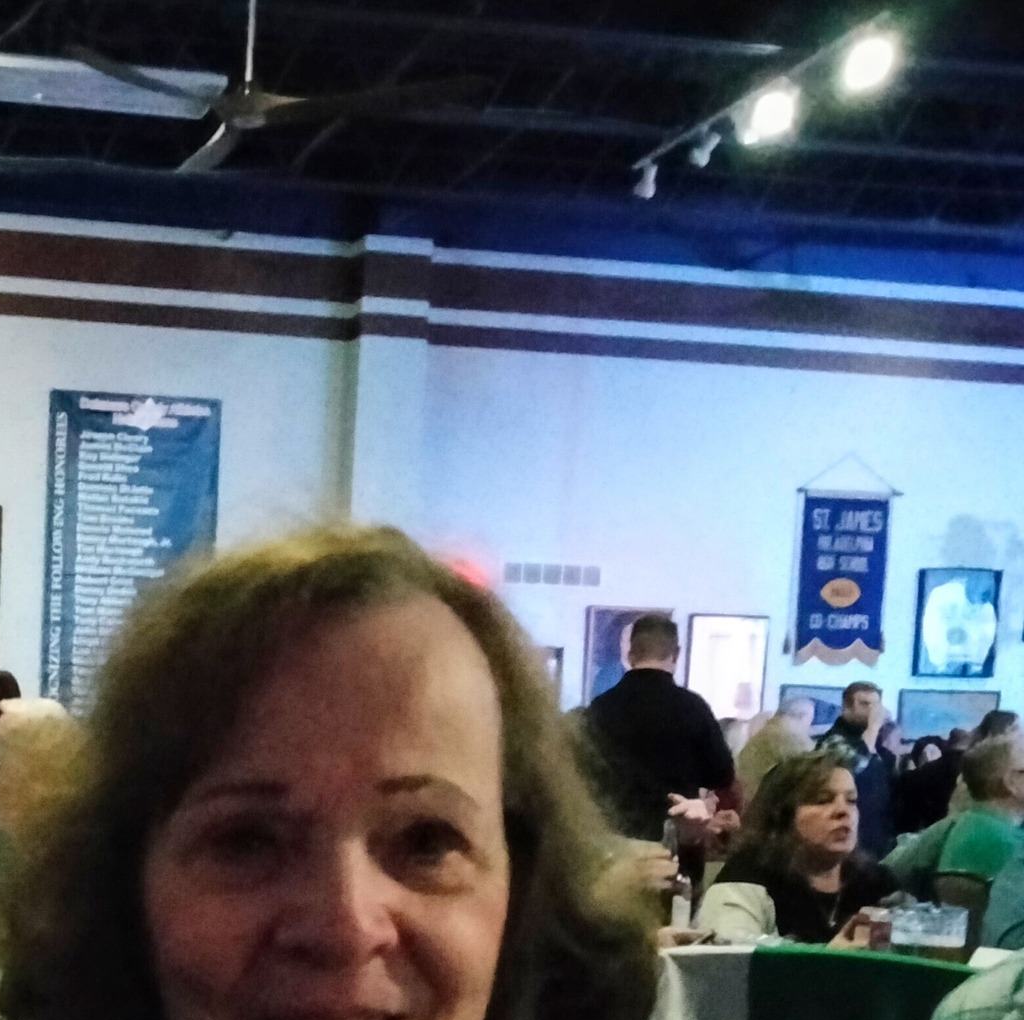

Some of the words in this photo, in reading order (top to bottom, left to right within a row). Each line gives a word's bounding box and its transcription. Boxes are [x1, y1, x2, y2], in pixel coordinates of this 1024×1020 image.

[835, 510, 883, 532] JAMES
[50, 498, 65, 590] FOLLOWING
[49, 593, 62, 623] THE
